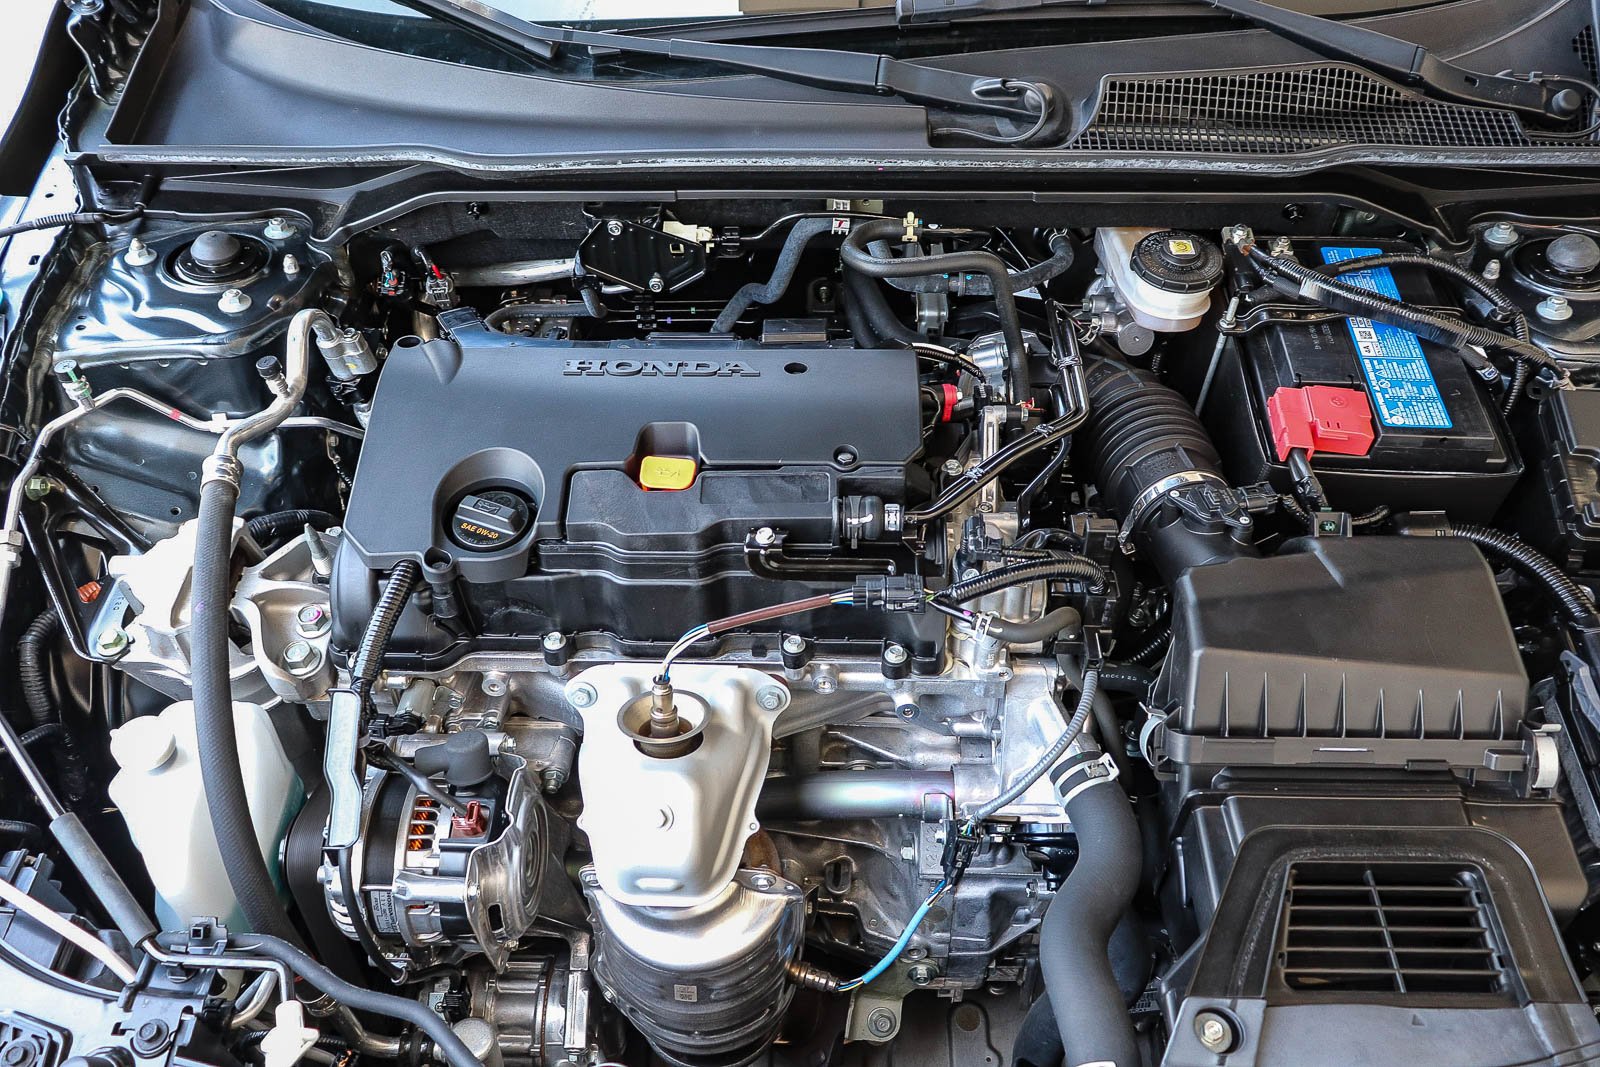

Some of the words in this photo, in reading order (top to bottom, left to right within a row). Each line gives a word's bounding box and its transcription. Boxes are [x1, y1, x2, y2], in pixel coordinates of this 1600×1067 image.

[563, 360, 761, 377] HONDA
[460, 522, 477, 532] SAE
[476, 527, 499, 539] 0W-20
